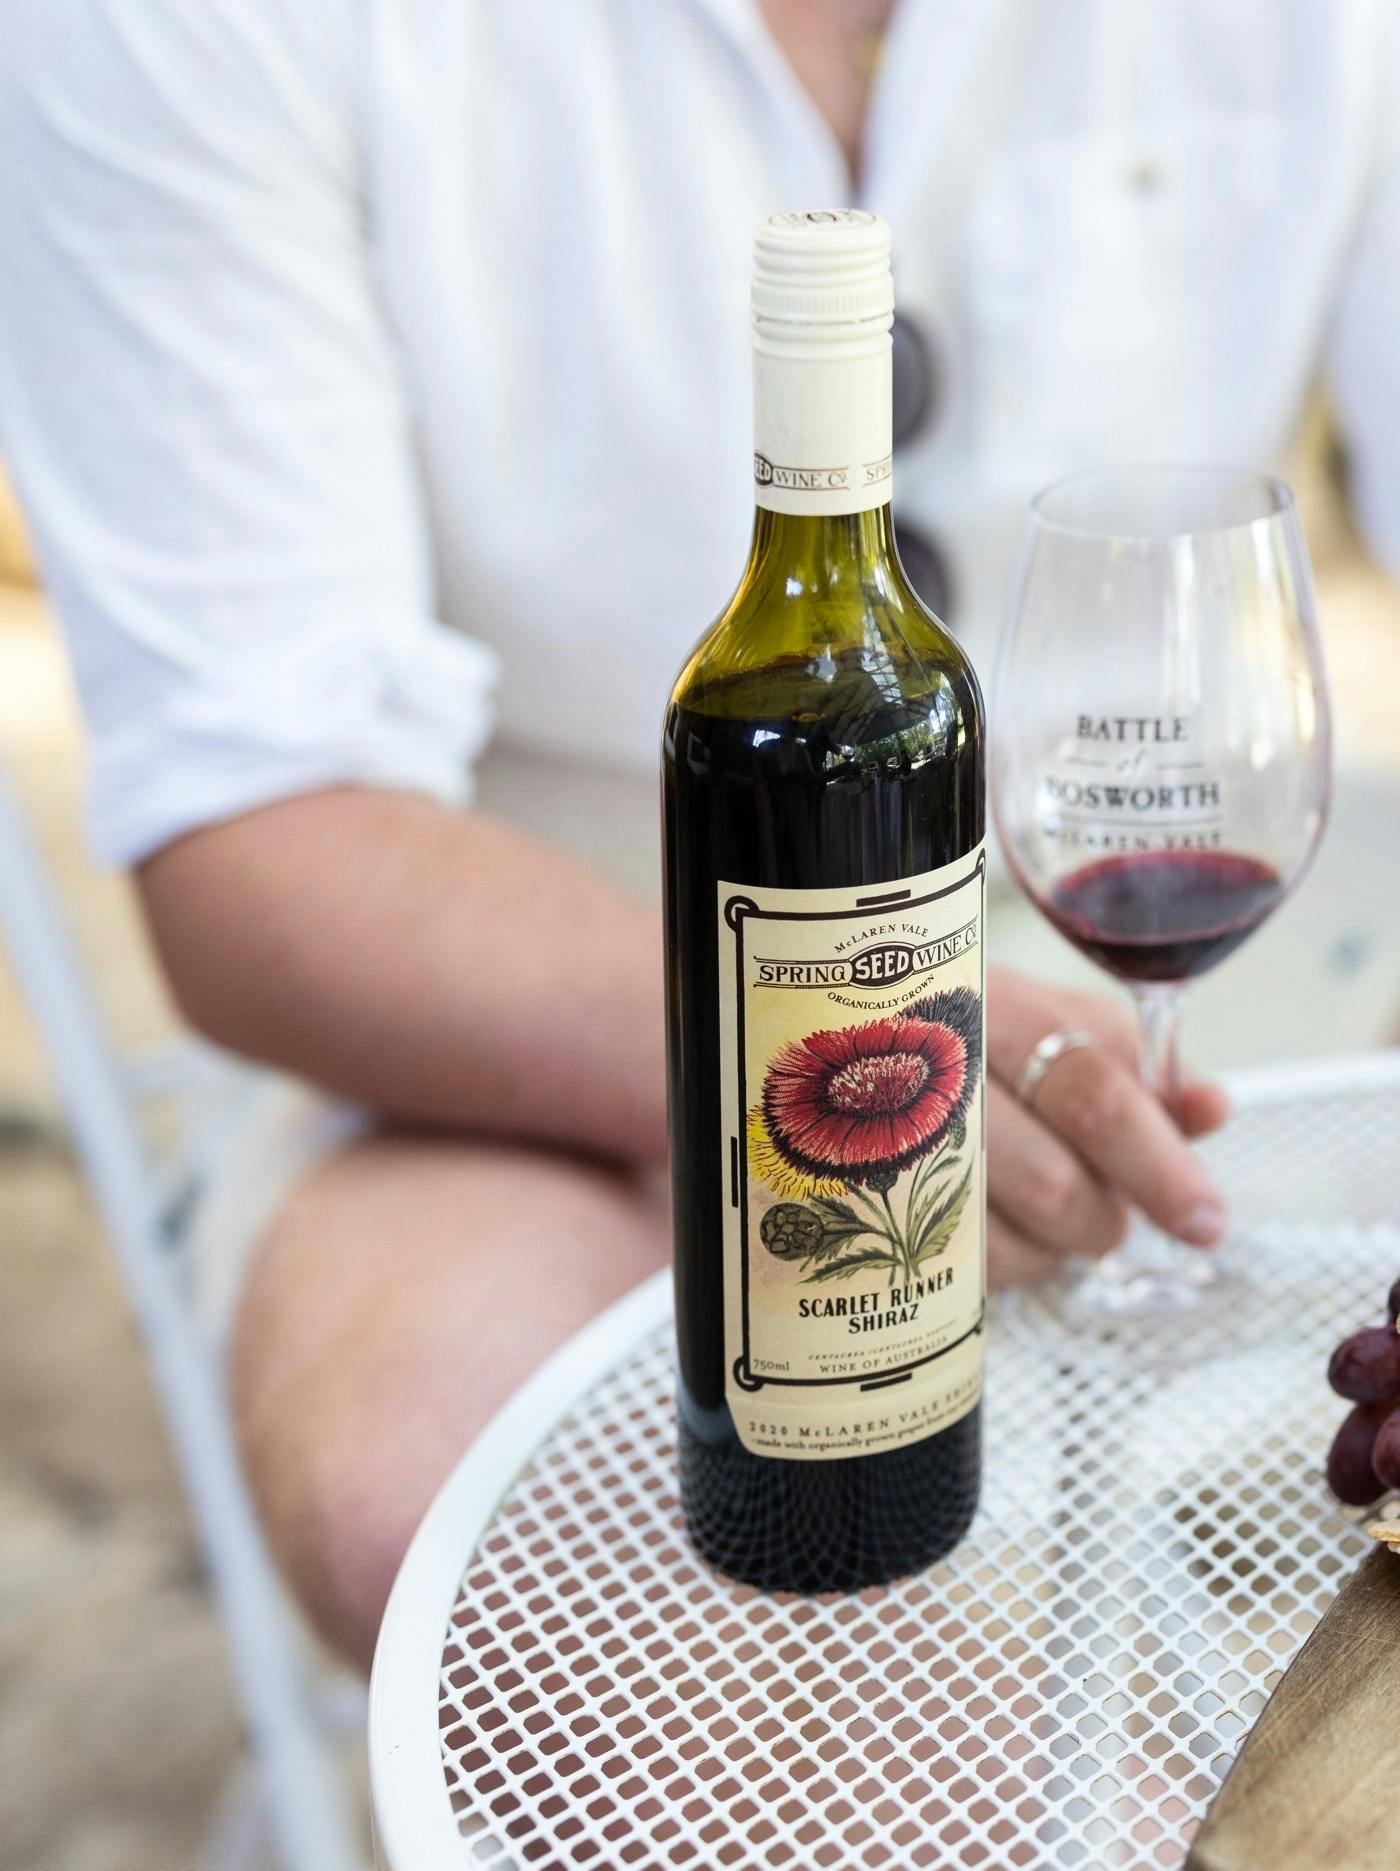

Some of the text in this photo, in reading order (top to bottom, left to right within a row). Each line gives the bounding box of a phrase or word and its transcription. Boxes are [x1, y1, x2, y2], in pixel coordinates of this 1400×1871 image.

[775, 469, 822, 487] WINE
[1077, 714, 1189, 743] BATTLE
[834, 923, 929, 953] McLAREN VALE
[759, 965, 845, 983] SPRING
[855, 950, 909, 980] SEED
[916, 935, 962, 967] WINE
[827, 974, 935, 1010] ORGANICALLY GROWN
[799, 1267, 954, 1318] SCARLET RUNNER
[848, 1303, 919, 1334] SHIRAZ
[753, 1358, 790, 1372] 750ml
[819, 1336, 948, 1374] WINE OF AUSTRALIA
[750, 1421, 788, 1436] 2020
[799, 1419, 889, 1437] McLAREN
